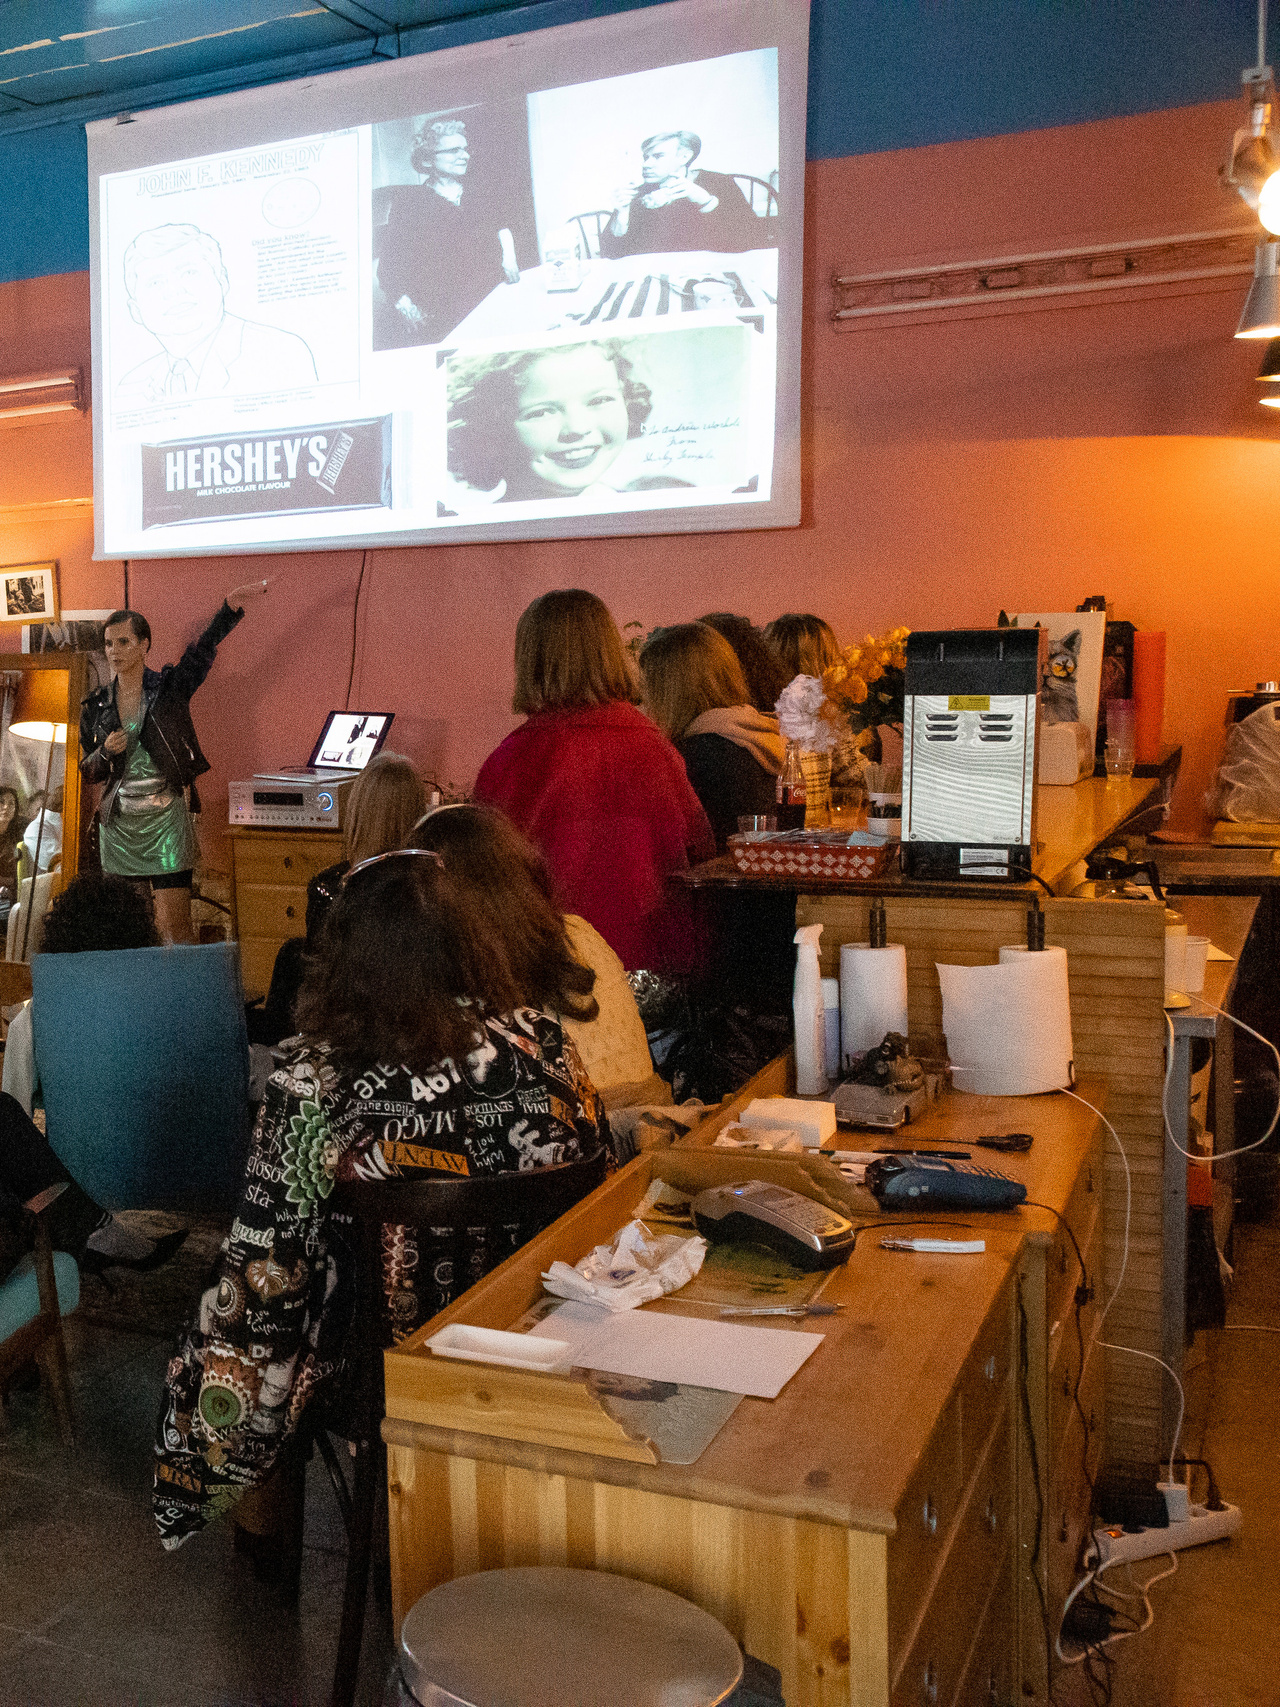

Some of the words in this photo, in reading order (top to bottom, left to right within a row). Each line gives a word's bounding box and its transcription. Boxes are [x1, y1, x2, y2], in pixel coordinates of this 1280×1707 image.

[136, 168, 192, 196] JOHN
[197, 164, 214, 184] F.
[220, 143, 324, 180] KENNEDY
[166, 436, 327, 491] HERSHEY'S
[197, 488, 212, 496] MILK
[216, 484, 256, 494] CHOCOLATE
[258, 482, 290, 490] FLAVOUR
[463, 1100, 514, 1117] SENTIDOS
[475, 1113, 503, 1128] LOS
[383, 1109, 457, 1142] MAGO
